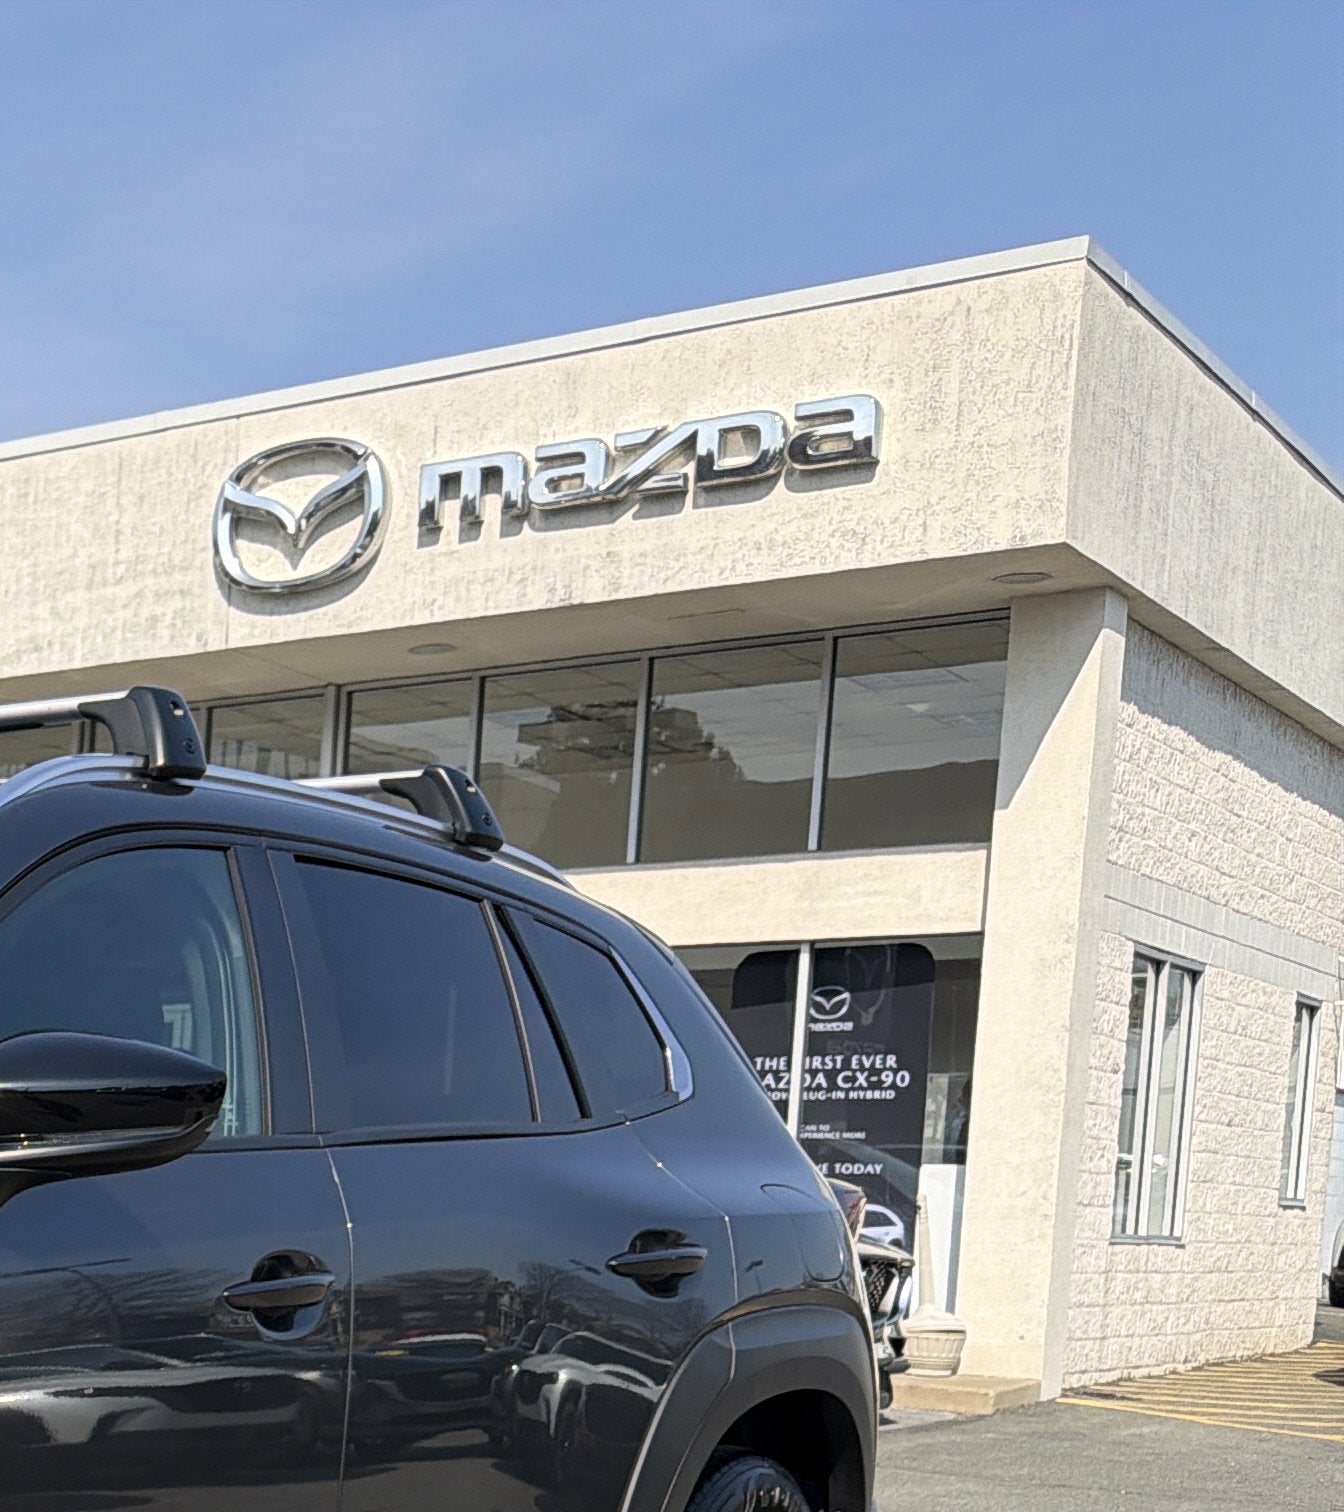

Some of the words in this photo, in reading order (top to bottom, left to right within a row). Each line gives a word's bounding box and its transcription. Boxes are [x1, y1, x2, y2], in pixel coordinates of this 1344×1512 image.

[418, 394, 880, 528] mazda
[754, 1056, 788, 1070] THE
[804, 1054, 844, 1070] IRST
[851, 1054, 897, 1069] EVER
[761, 1072, 827, 1088] AZA
[837, 1070, 910, 1088] CX-90
[802, 1090, 845, 1101] LUG-IN
[849, 1089, 896, 1100] HYBRID
[833, 1163, 883, 1174] TODAY
